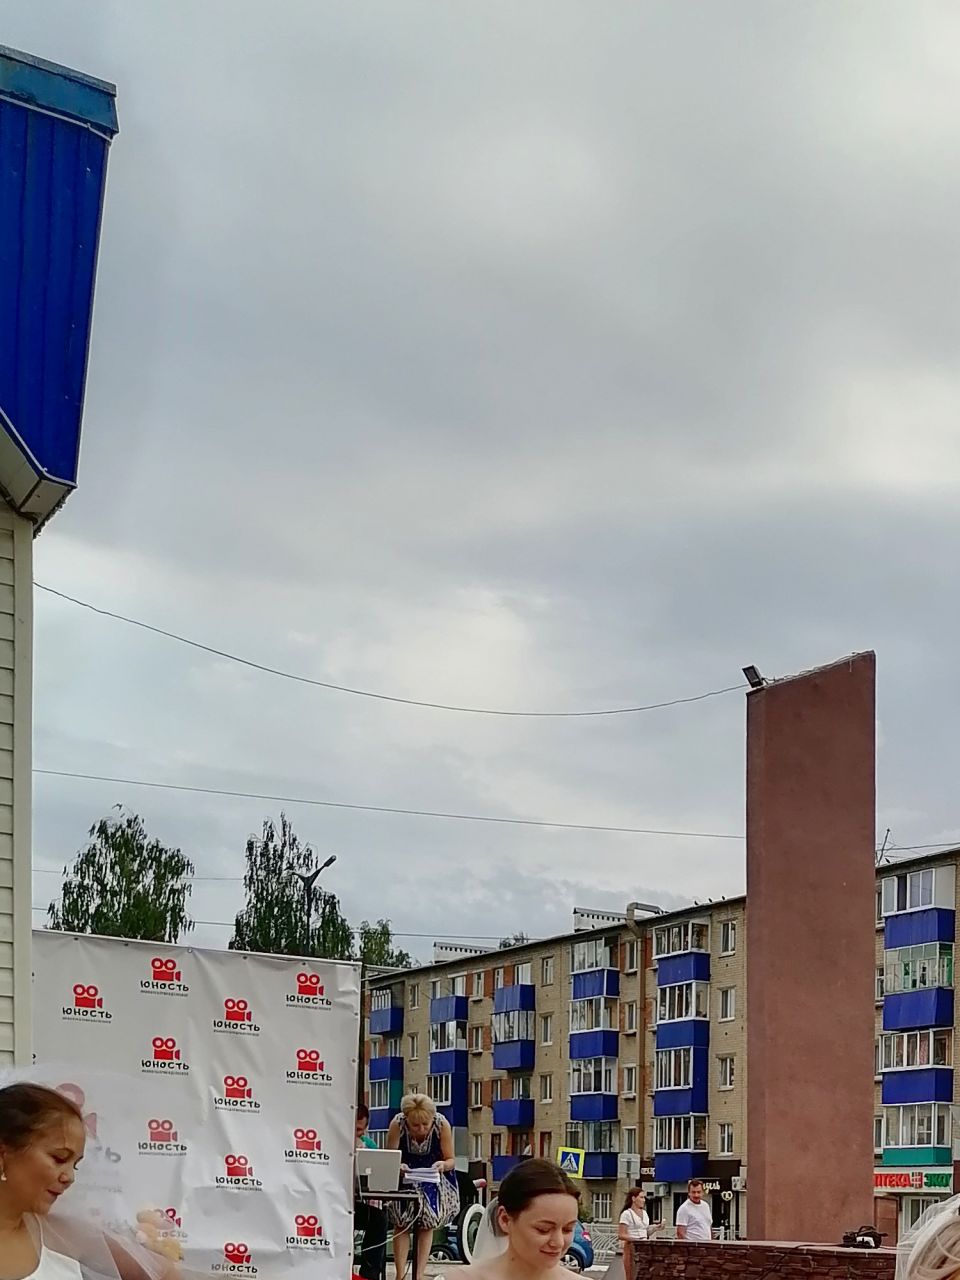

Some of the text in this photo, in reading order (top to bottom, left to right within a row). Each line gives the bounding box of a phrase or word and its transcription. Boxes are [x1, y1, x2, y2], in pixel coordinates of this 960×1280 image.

[140, 980, 190, 992] ЮНОСТЬ
[286, 994, 332, 1006] ЮНОСТЬ
[62, 1006, 113, 1019] ЮНОСТЬ
[213, 1020, 261, 1032] ЮНОСТЬ
[141, 1059, 190, 1071] ЮНОСТЬ
[286, 1071, 333, 1082] ЮНОСТЬ
[214, 1097, 261, 1109] ЮНОСТЬ
[138, 1142, 188, 1151] ЮНОСТЬ
[284, 1150, 330, 1161] ЮНОСТЬ
[215, 1176, 263, 1187] ЮНОСТЬ
[285, 1236, 331, 1247] ЮНОСТЬ
